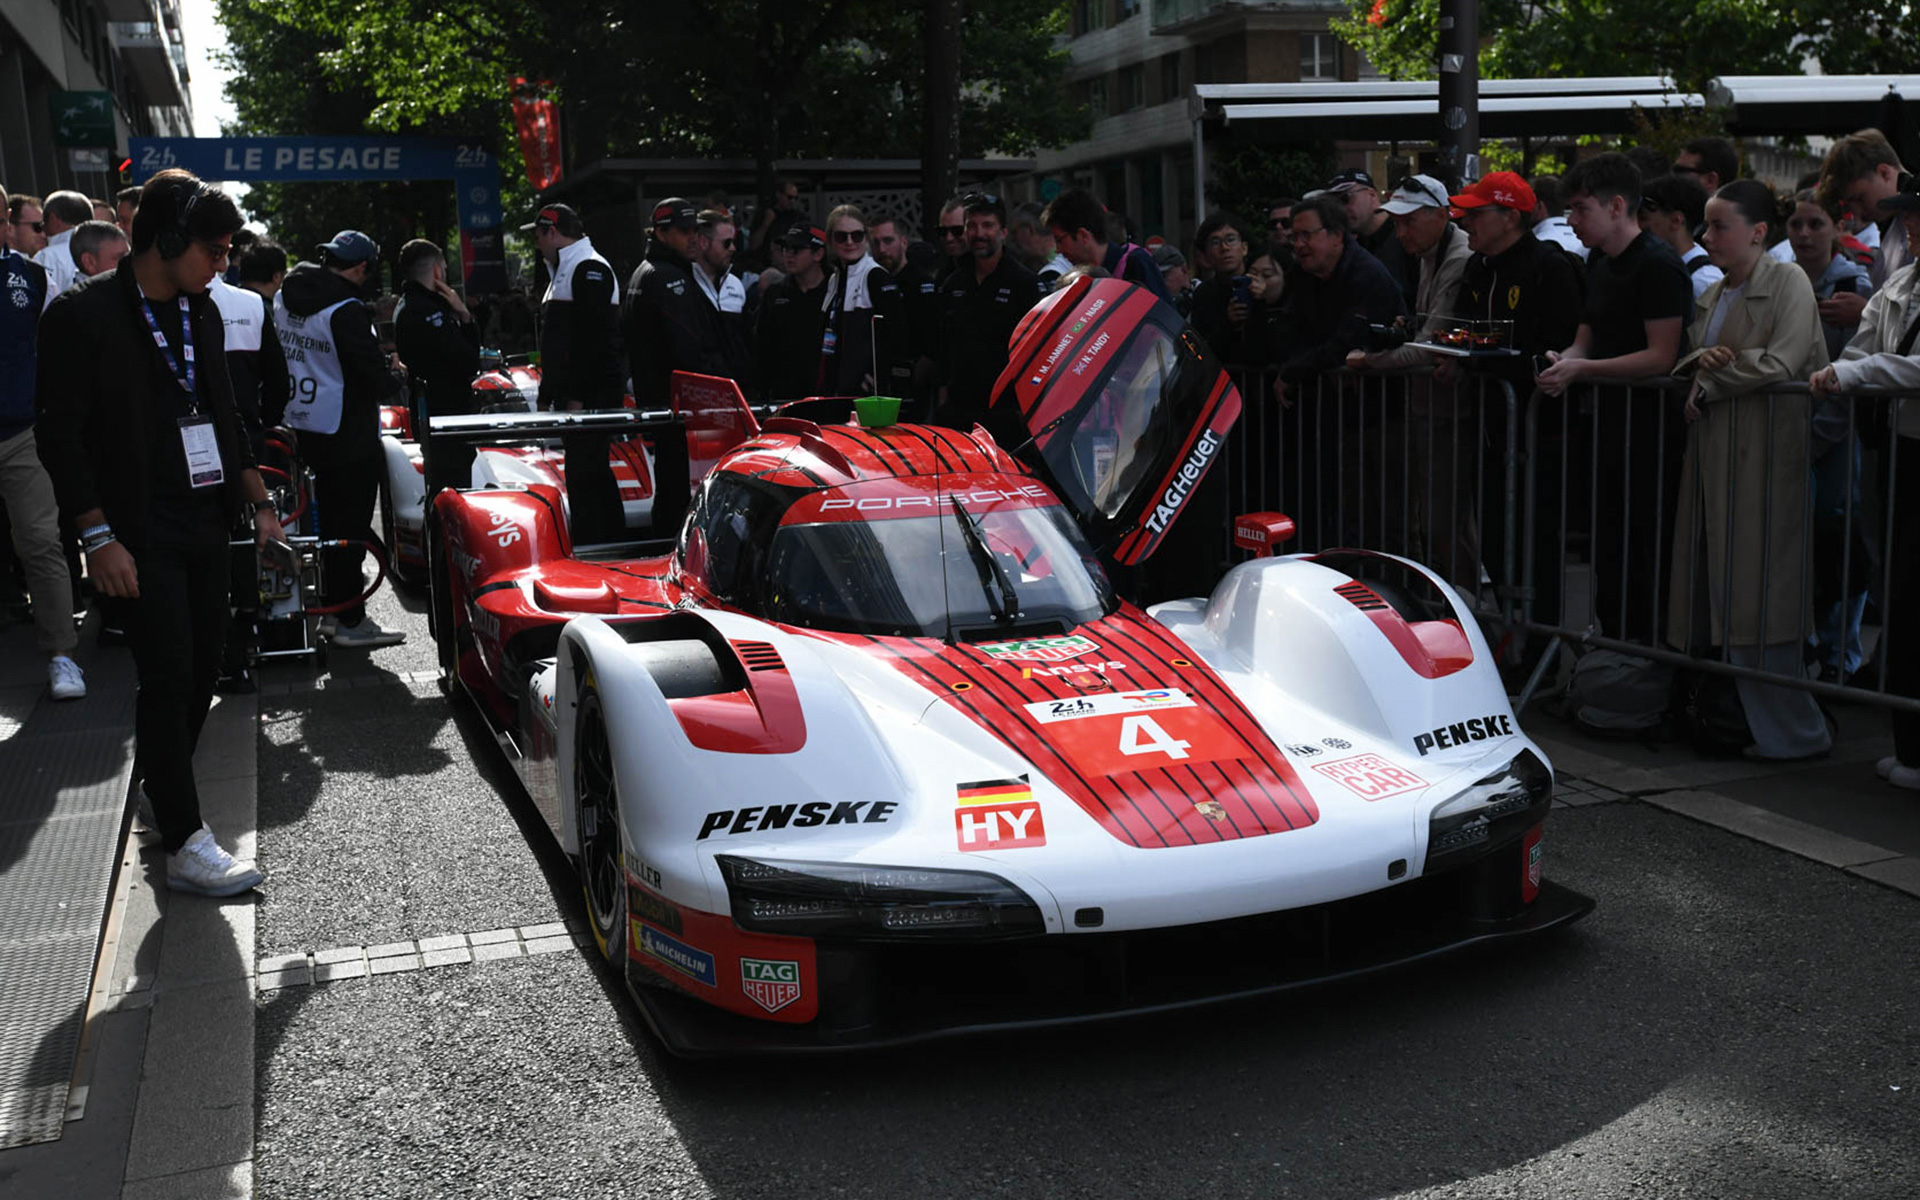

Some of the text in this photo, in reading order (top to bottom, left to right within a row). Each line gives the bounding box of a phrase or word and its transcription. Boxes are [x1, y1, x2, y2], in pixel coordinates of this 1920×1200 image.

[224, 146, 402, 171] LE PESAGE
[1086, 298, 1106, 319] NASR
[1046, 333, 1074, 365] JAMINET
[1087, 331, 1111, 358] TANDY
[819, 484, 1048, 513] PORSCHE
[1238, 527, 1266, 543] HELLER
[1119, 715, 1192, 759] 4
[1413, 714, 1513, 756] PENSKE
[1319, 756, 1390, 779] HYPER
[1343, 768, 1423, 796] CAR
[696, 801, 899, 840] PENSKE
[961, 808, 1036, 843] HY
[655, 940, 707, 974] MICHELIN
[744, 963, 794, 981] TAG
[745, 982, 797, 1008] HEUER
